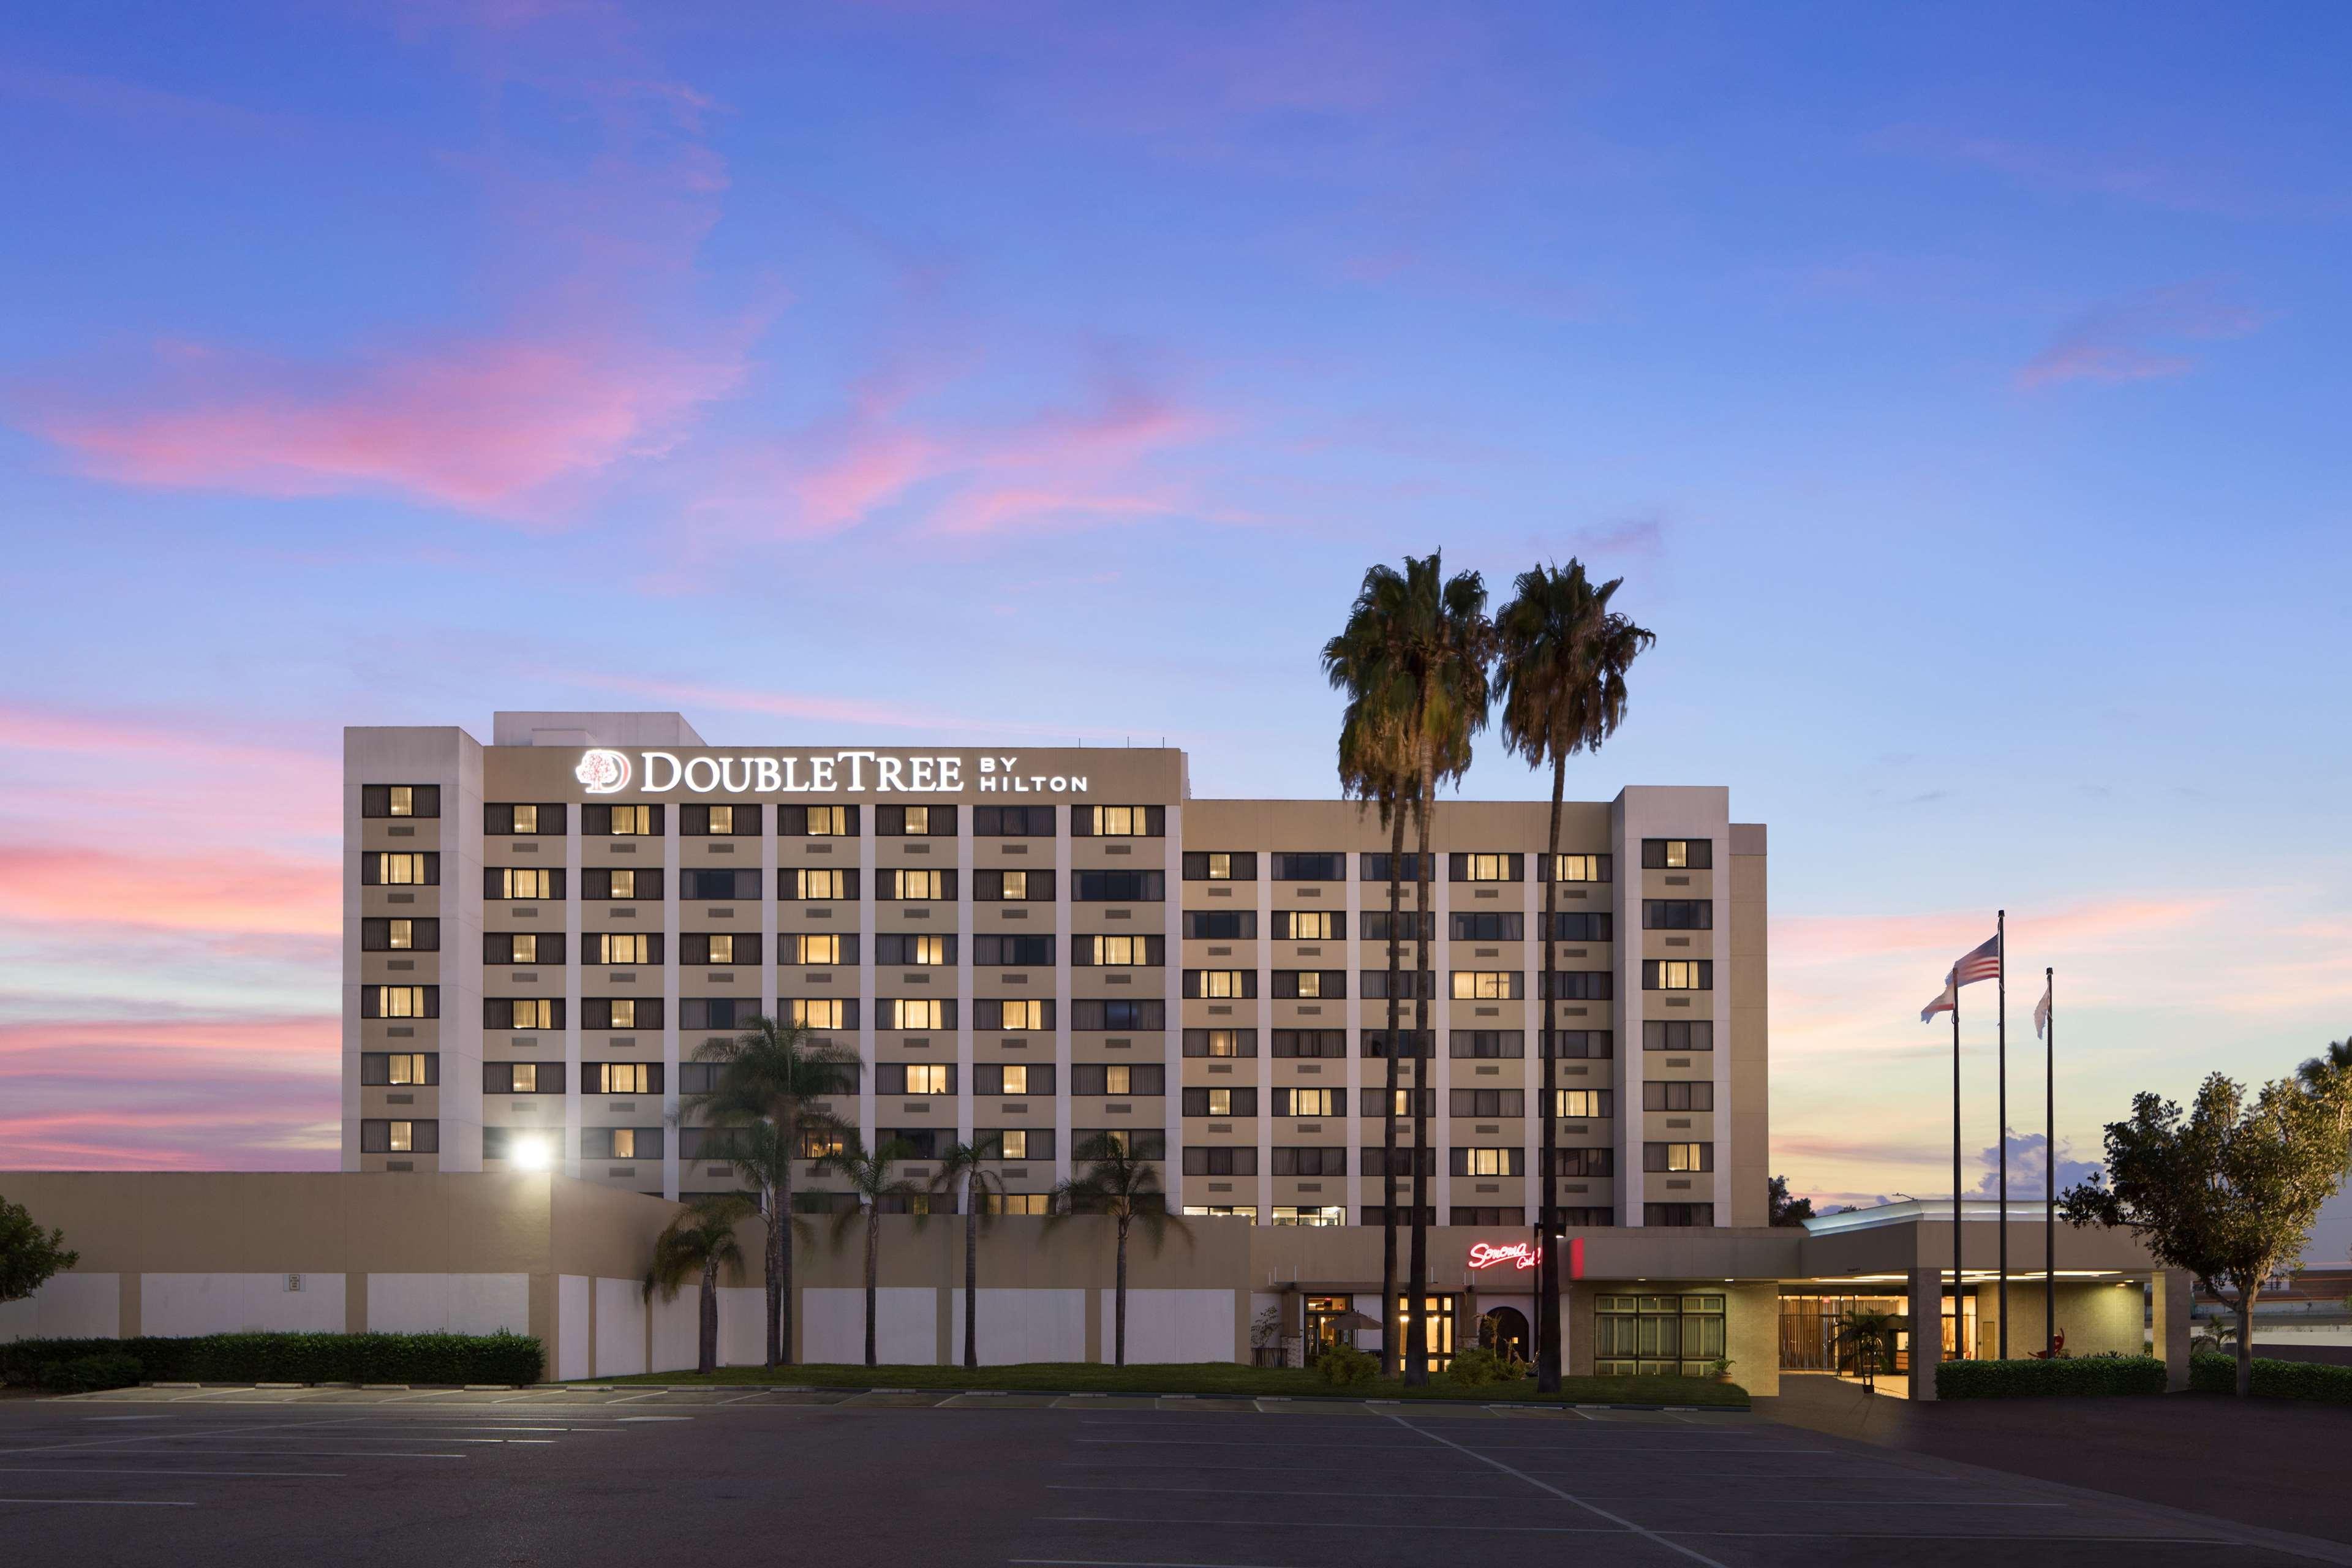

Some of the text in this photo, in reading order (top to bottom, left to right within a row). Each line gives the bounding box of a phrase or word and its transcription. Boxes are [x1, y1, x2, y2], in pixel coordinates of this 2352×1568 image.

[641, 752, 964, 793] DOUBLETREE
[980, 757, 1017, 772] BY
[980, 776, 1087, 792] HILTON
[1469, 1243, 1527, 1267] Sonoma
